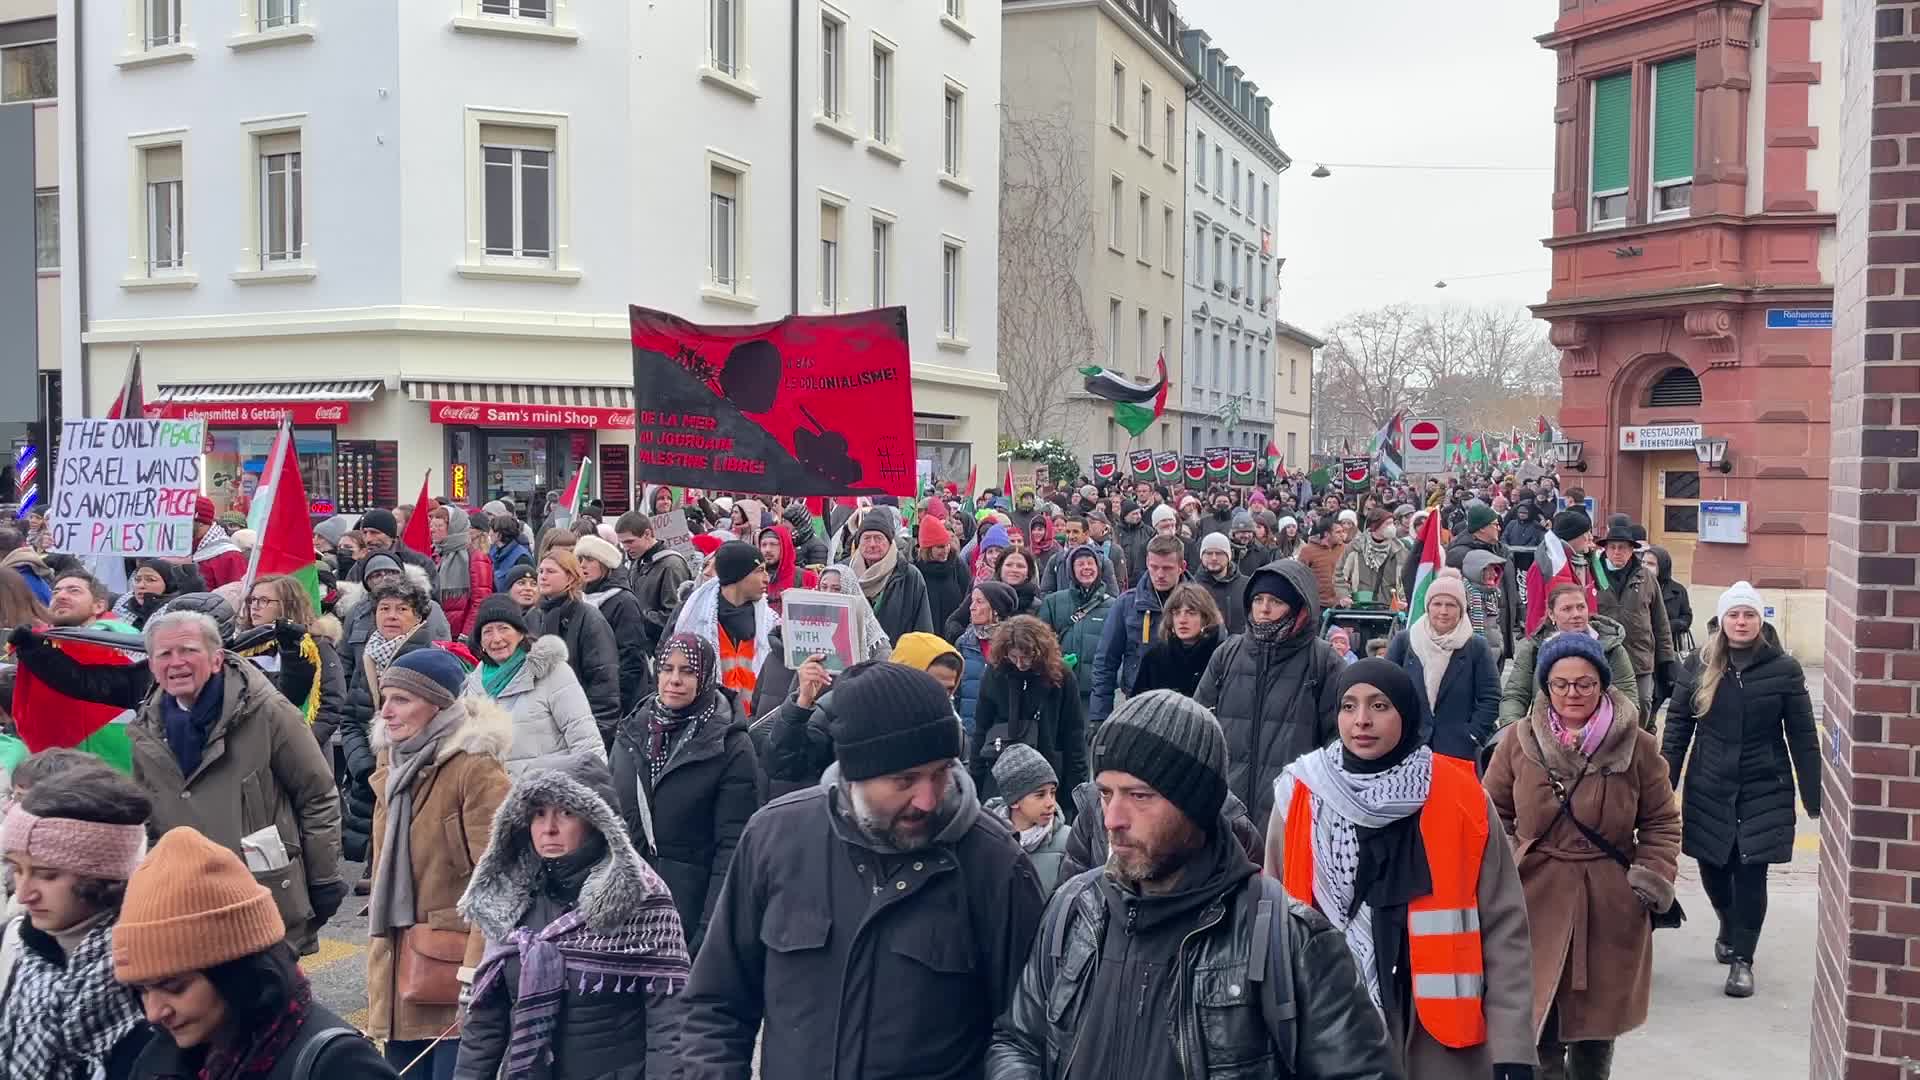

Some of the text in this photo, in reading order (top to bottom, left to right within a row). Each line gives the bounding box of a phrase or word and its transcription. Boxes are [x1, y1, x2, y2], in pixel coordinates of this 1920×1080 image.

[183, 407, 239, 420] Lebensmittel
[241, 407, 248, 420] &
[439, 405, 480, 420] Coca-Cola
[487, 408, 597, 428] Sam's mini Shop
[640, 410, 719, 431] DE LA MER
[64, 421, 108, 450] THE
[112, 420, 160, 449] ONLY
[1640, 426, 1699, 438] RESTAURANT
[60, 456, 201, 486] ISRAEL WANTS
[55, 487, 199, 519] IS ANOTHER PIECE
[53, 522, 193, 552] OF PALESTINE
[795, 631, 820, 643] WITH
